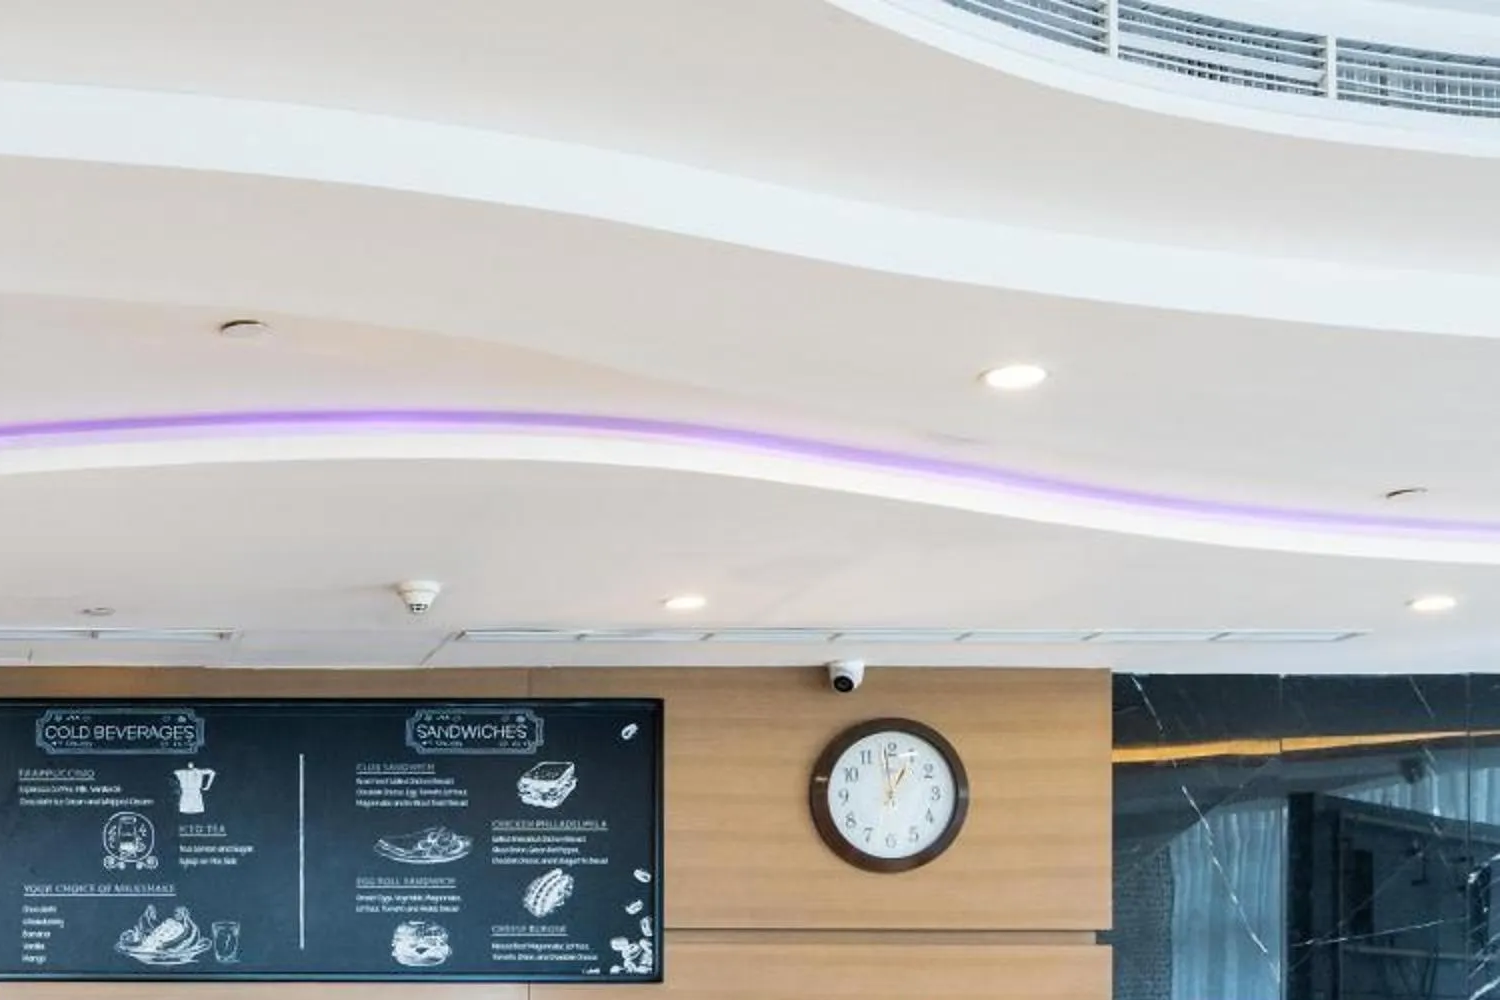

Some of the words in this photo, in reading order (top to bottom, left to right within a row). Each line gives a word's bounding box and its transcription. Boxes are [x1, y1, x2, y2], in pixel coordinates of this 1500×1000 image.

[45, 724, 90, 740] COLD
[94, 724, 195, 740] BEVERAGES
[416, 724, 528, 740] SANDWICHES
[844, 767, 859, 783] 10
[838, 788, 849, 805] 9
[931, 786, 941, 801] 3
[925, 808, 933, 824] 4
[207, 824, 226, 833] TEA
[863, 827, 874, 843] 7
[908, 827, 919, 843] 5
[885, 834, 897, 848] 6
[24, 884, 52, 893] YOUR
[55, 884, 94, 893] CHOICE
[98, 884, 111, 893] OF
[114, 884, 175, 893] MILKSHAKE
[356, 877, 376, 886] EGG
